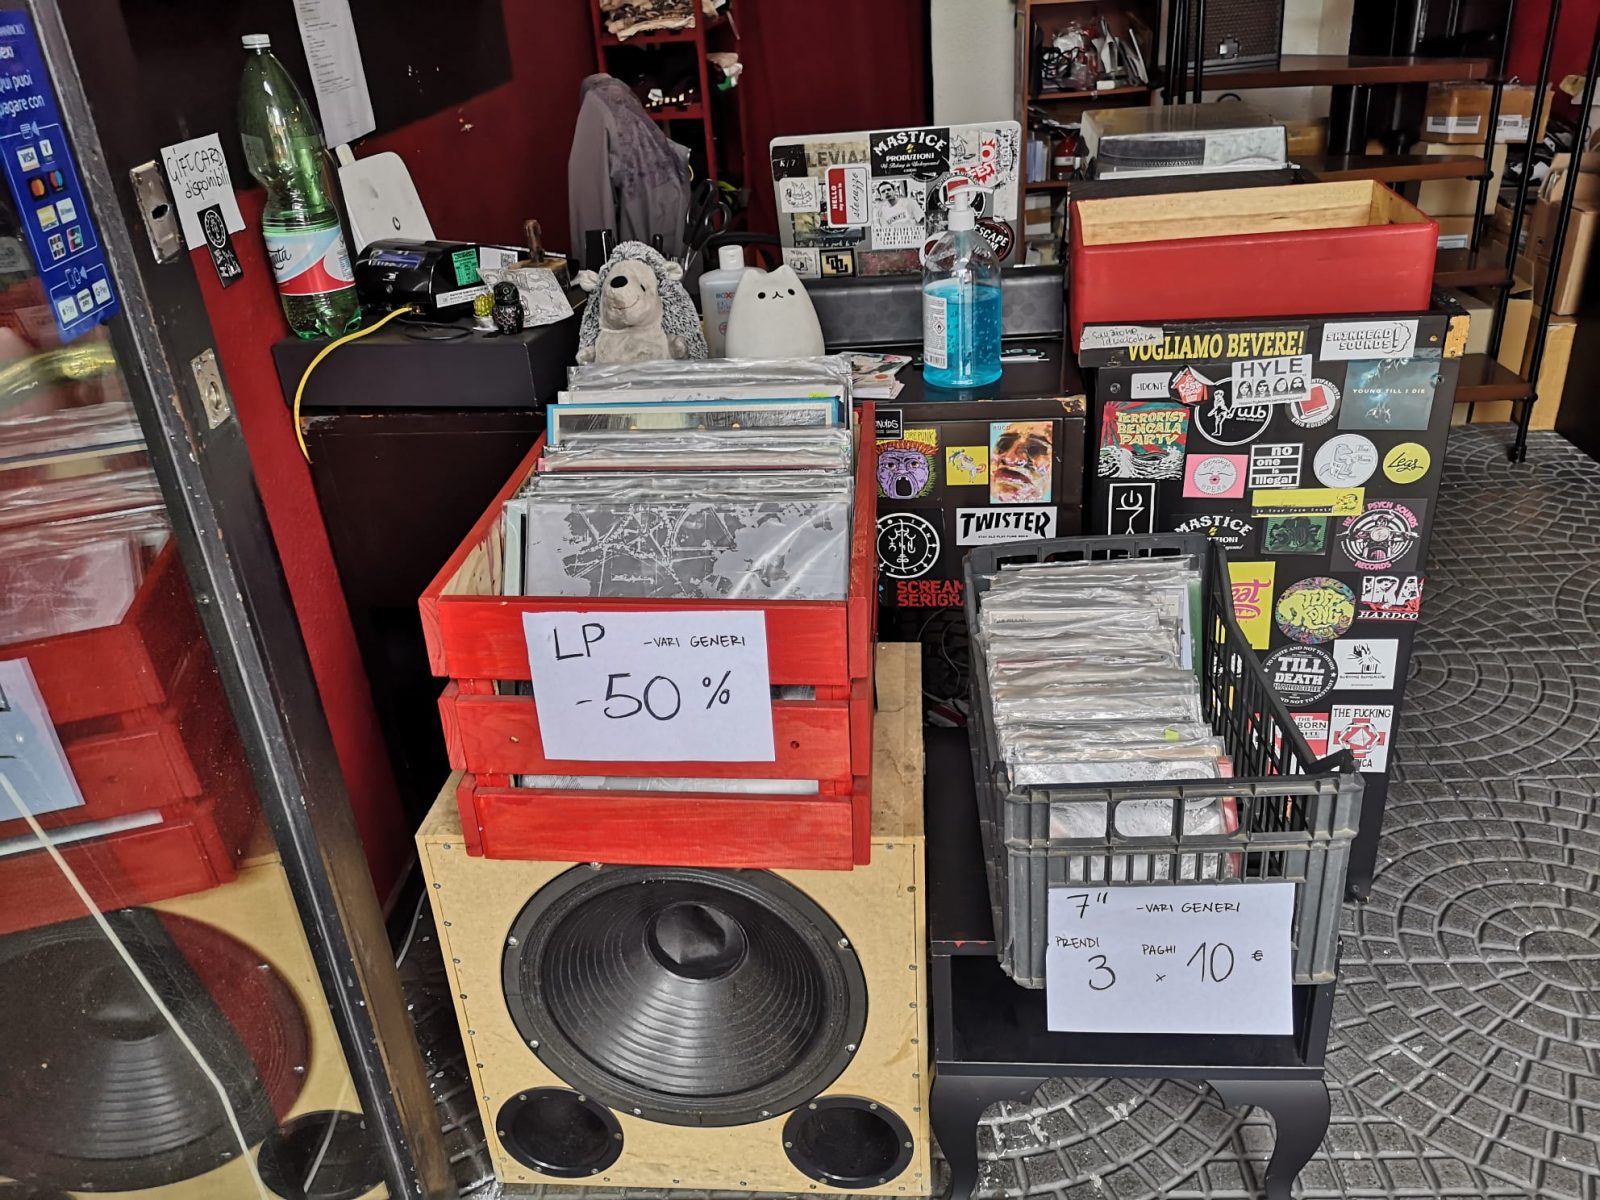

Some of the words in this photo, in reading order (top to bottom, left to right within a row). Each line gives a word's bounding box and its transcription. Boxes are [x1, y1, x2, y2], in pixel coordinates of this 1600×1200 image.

[28, 95, 45, 110] con
[873, 130, 947, 156] MASTICE
[886, 152, 935, 162] PRODUZIONI
[185, 165, 231, 200] disponibili
[830, 185, 838, 209] HELLO
[974, 224, 1009, 247] ESCAPE
[1128, 332, 1224, 361] VOGLIAMO
[1227, 330, 1303, 356] BEVERE!
[1240, 358, 1303, 378] HYLE
[1116, 411, 1186, 424] TERRORIST
[1291, 416, 1305, 428] ERIS
[1117, 422, 1182, 434] BENGALA
[1120, 433, 1180, 446] PARTY
[1271, 446, 1293, 456] no
[1256, 458, 1281, 466] one
[1367, 502, 1394, 510] PSYCH
[1394, 504, 1419, 528] SOUNDS
[960, 511, 1050, 539] TWISTER
[1174, 515, 1254, 536] MASTICE
[1354, 561, 1392, 570] RECORDS
[1231, 579, 1272, 604] eat
[897, 594, 964, 607] SERIGR
[554, 622, 605, 660] LP
[643, 637, 680, 648] -VARI
[690, 636, 745, 648] GENERI
[1266, 658, 1274, 666] TO
[1278, 656, 1326, 674] TILL
[1274, 672, 1324, 686] DEATH
[576, 673, 681, 720] -50
[702, 670, 732, 710] %
[1334, 708, 1352, 718] THE
[1354, 708, 1392, 718] FUCKING
[1358, 758, 1373, 768] ICA
[1182, 902, 1240, 914] GENERI
[1055, 936, 1100, 949] PRENDI
[1142, 944, 1176, 956] PAGHI
[1088, 954, 1116, 990] 3
[1186, 942, 1234, 982] 10
[1251, 950, 1264, 962] €
